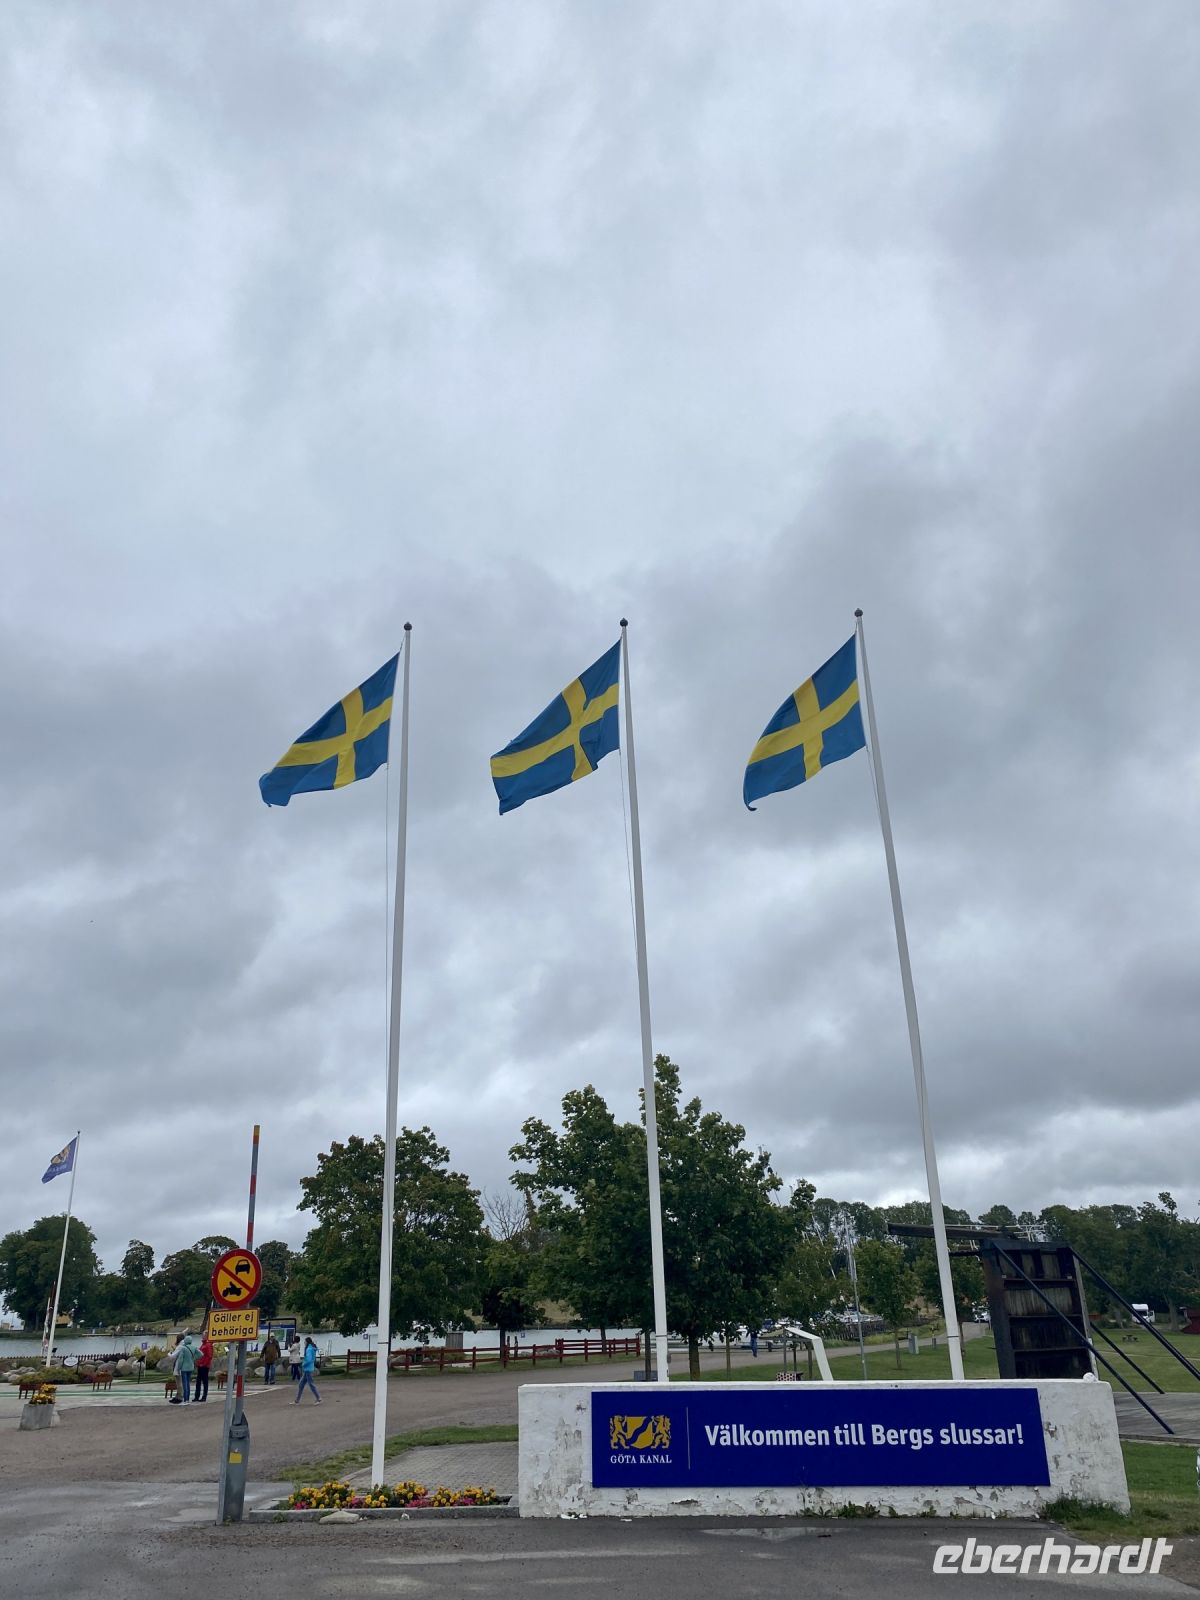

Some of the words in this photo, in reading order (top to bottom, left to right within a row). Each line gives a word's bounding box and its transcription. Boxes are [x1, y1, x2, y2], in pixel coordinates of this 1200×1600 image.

[213, 1313, 241, 1323] Gäller
[244, 1311, 254, 1323] ej
[211, 1325, 254, 1337] behöriga
[704, 1424, 830, 1446] Välkommen
[834, 1423, 866, 1446] till
[871, 1424, 934, 1450] Bergs
[939, 1422, 1024, 1446] slussar!
[610, 1454, 637, 1464] GÖTA
[639, 1454, 672, 1464] KANAL
